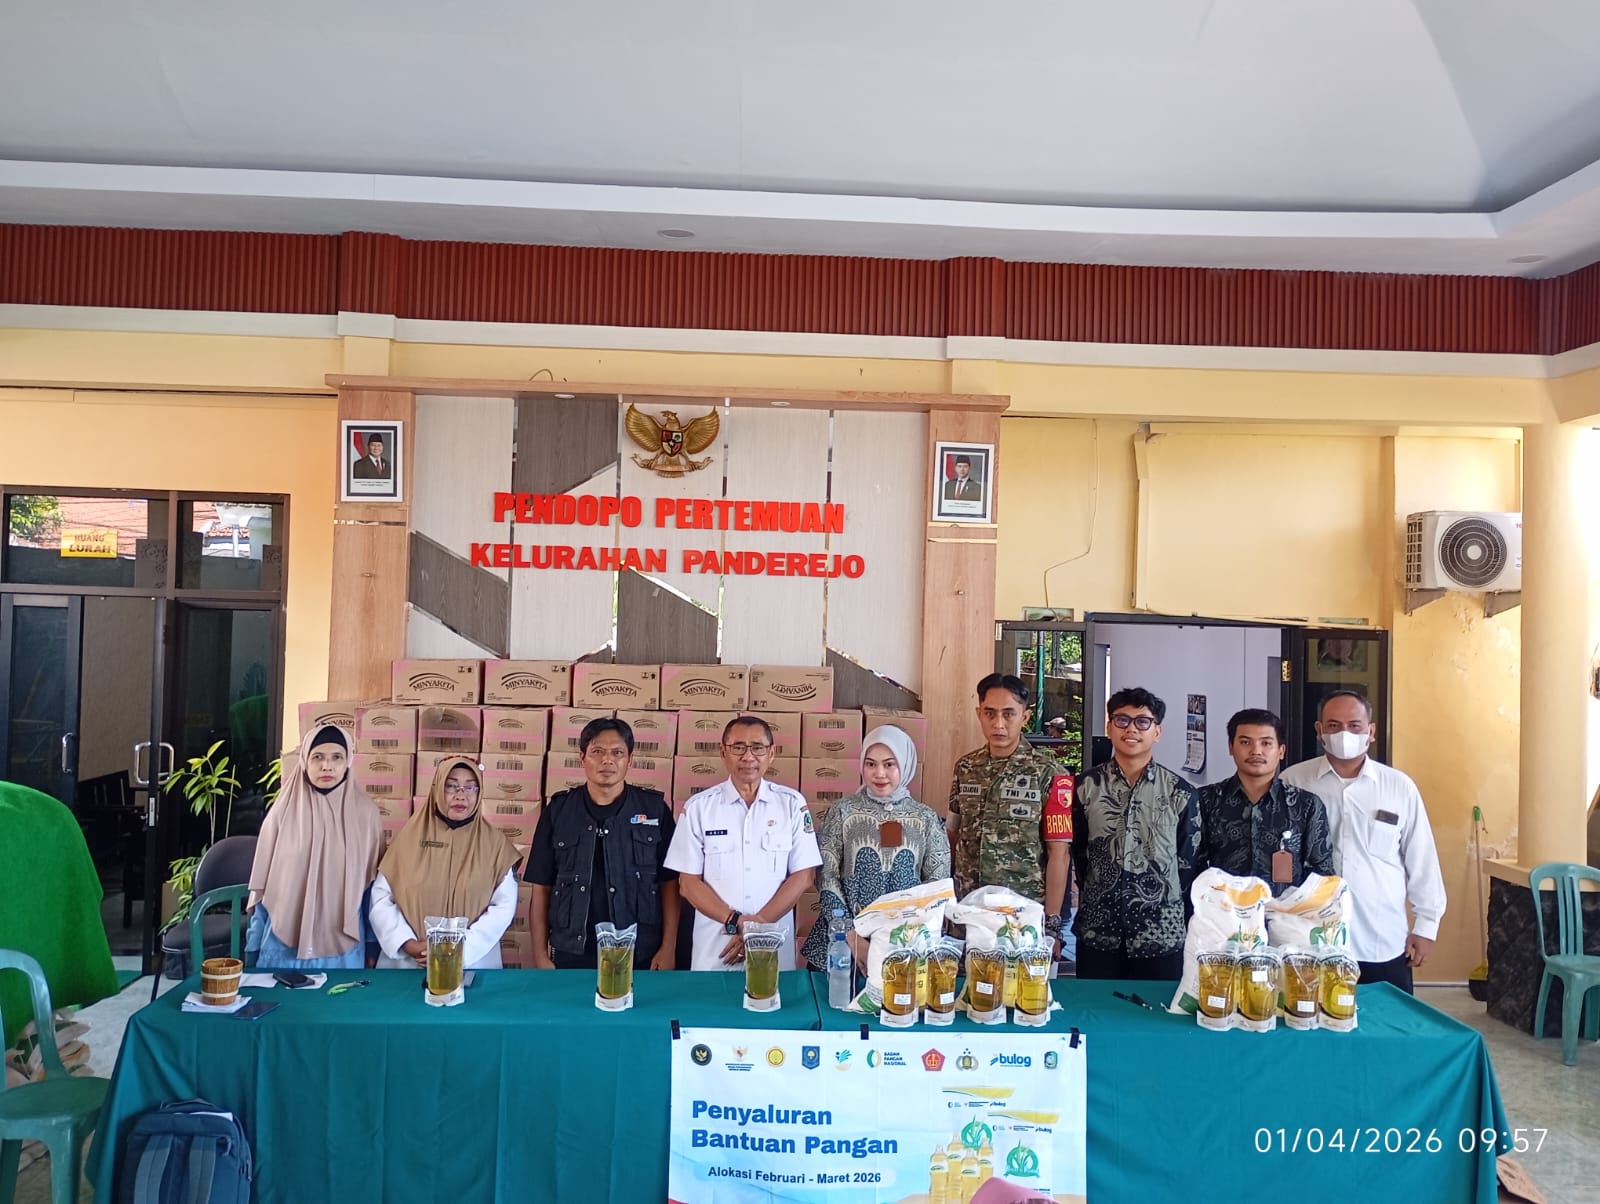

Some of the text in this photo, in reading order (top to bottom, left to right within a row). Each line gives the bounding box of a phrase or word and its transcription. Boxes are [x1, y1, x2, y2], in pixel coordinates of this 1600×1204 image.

[494, 492, 845, 534] PENDOPO PERTEMUAN
[75, 534, 104, 542] RUANG
[470, 543, 865, 579] KELURAHAN PANDEREJO
[412, 679, 455, 692] MINYAKITA
[505, 679, 548, 691] MINYAKITA
[595, 685, 637, 697] MINYAKITA
[683, 685, 726, 697] MINYAKITA
[771, 682, 813, 695] MINYAKITA
[1005, 789, 1037, 799] TNI AD
[999, 1053, 1032, 1067] bulog
[691, 1100, 833, 1126] Penyaluran
[691, 1129, 899, 1159] Bantuan Pangan
[707, 1166, 753, 1180] Alokasi
[755, 1169, 806, 1184] Februari
[816, 1172, 851, 1184] Maret
[853, 1172, 882, 1183] 2026
